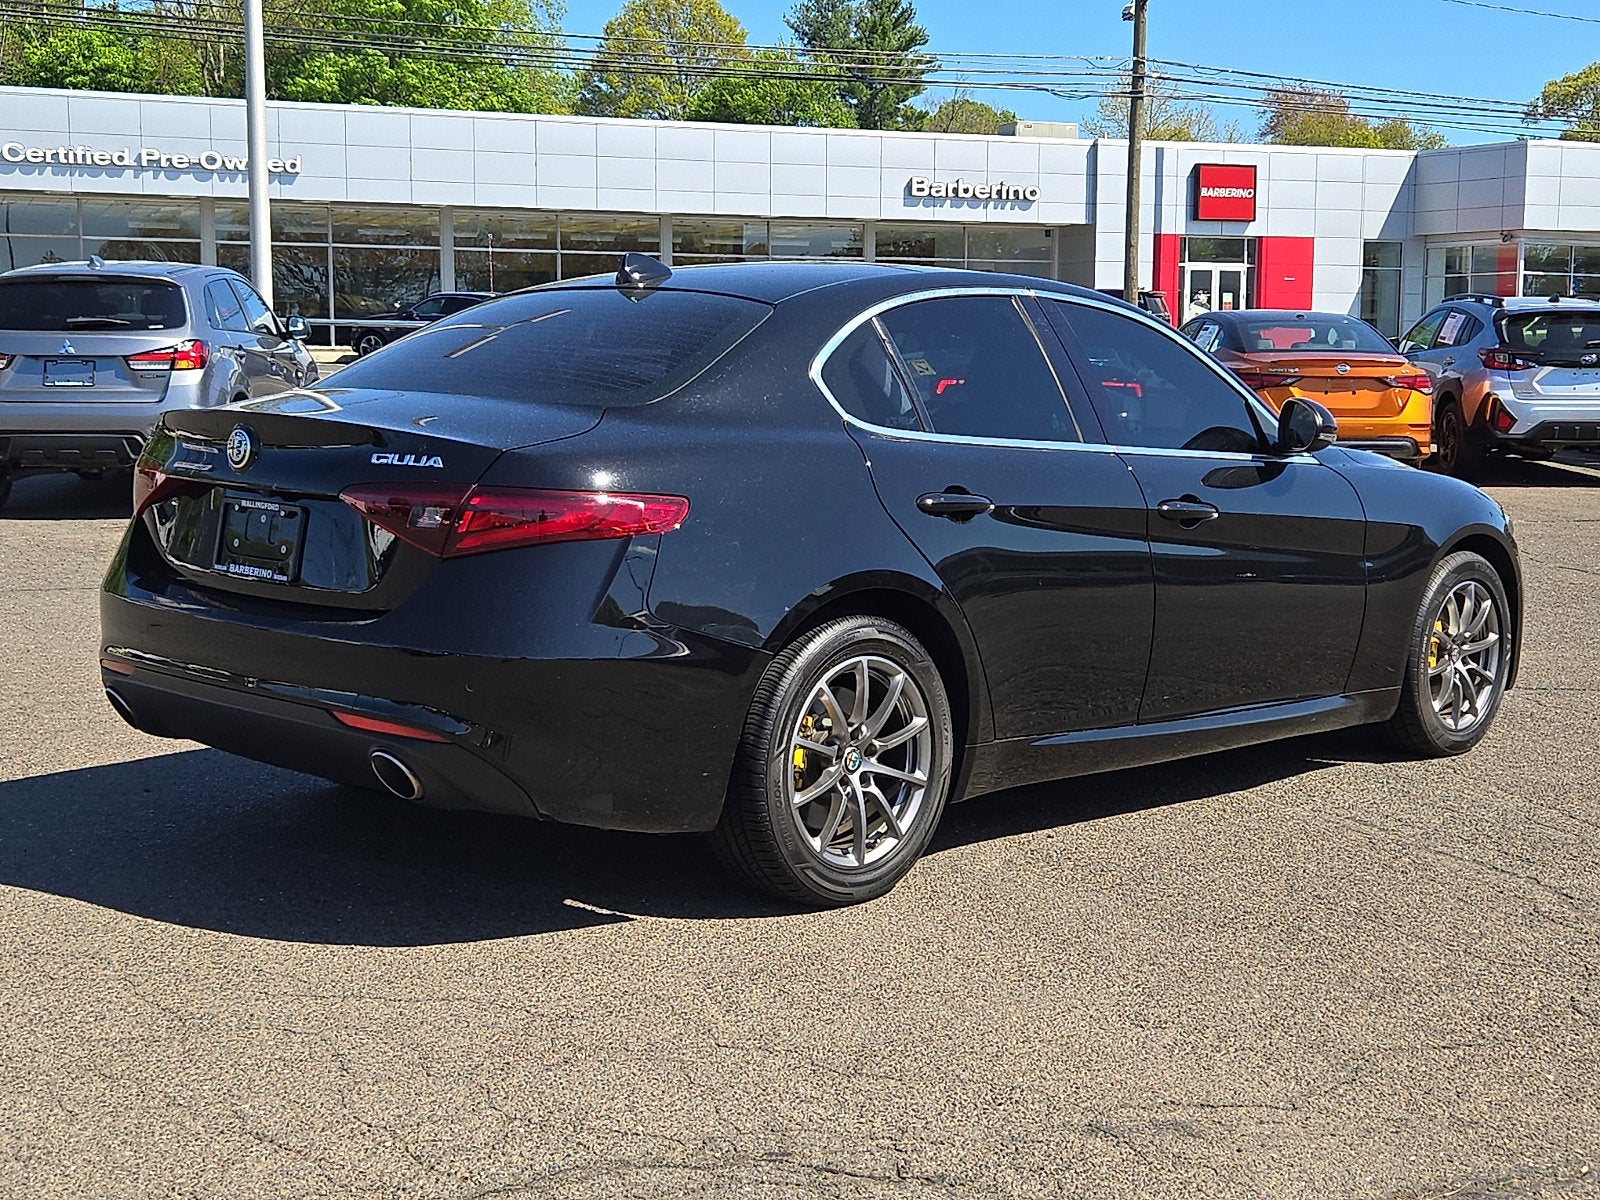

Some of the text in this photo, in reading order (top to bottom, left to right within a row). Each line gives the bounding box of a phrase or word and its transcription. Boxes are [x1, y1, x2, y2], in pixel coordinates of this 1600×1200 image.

[1, 141, 302, 174] Certified Pre-Owed
[911, 176, 1041, 201] Barberino
[1200, 187, 1255, 199] BARBERINO
[370, 453, 444, 468] GIULIA
[229, 563, 273, 579] BARBERINO
